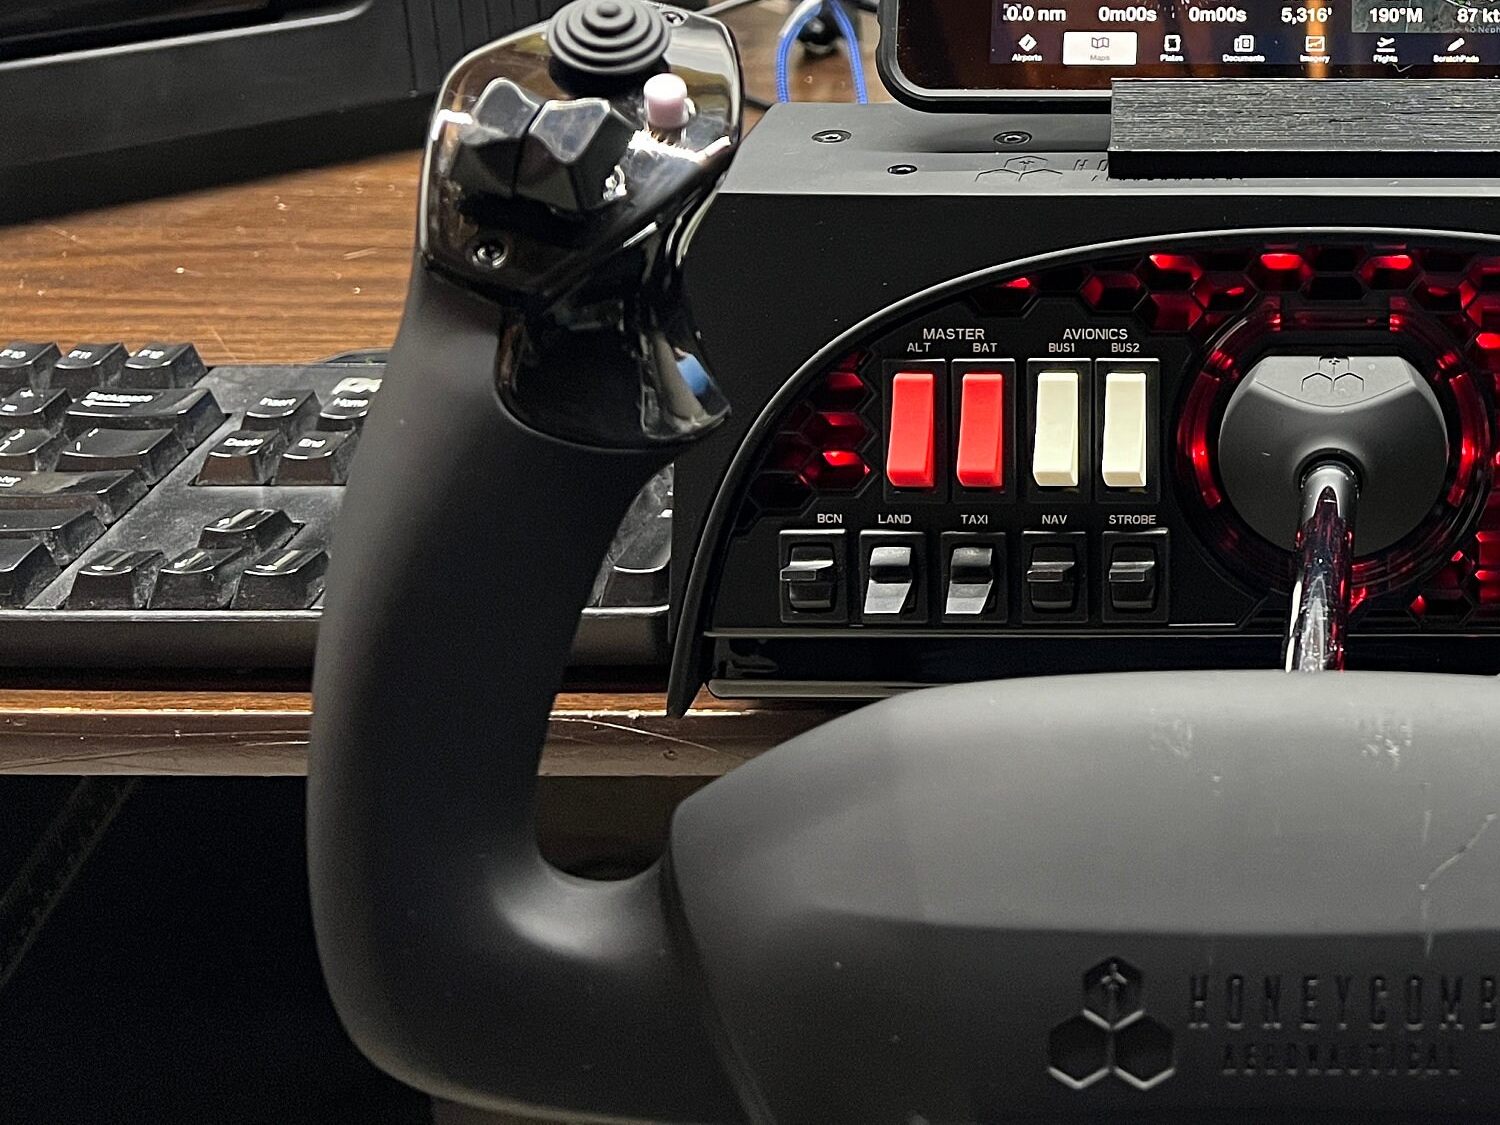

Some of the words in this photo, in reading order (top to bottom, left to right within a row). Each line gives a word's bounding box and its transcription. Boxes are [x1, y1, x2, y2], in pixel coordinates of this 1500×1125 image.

[1006, 6, 1035, 22] 0.0
[1037, 8, 1067, 22] nm
[1099, 6, 1157, 22] 0m00s
[1188, 7, 1248, 23] 0m00s
[1456, 8, 1478, 23] 87
[1012, 54, 1042, 63] Airports
[1222, 54, 1265, 63] Documents
[1373, 55, 1398, 64] Flights
[922, 328, 985, 341] MASTER
[1062, 328, 1128, 341] AVIONICS
[906, 342, 931, 354] ALT
[972, 342, 998, 354] BAT
[1047, 342, 1076, 354] BUS1
[1110, 342, 1141, 354] BUS2
[816, 513, 844, 525] BCN
[877, 513, 912, 525] LAND
[960, 513, 989, 526] TAXI
[1041, 513, 1068, 526] NAV
[1108, 513, 1157, 526] STROBE
[1188, 974, 1498, 1032] HONEYCOMB
